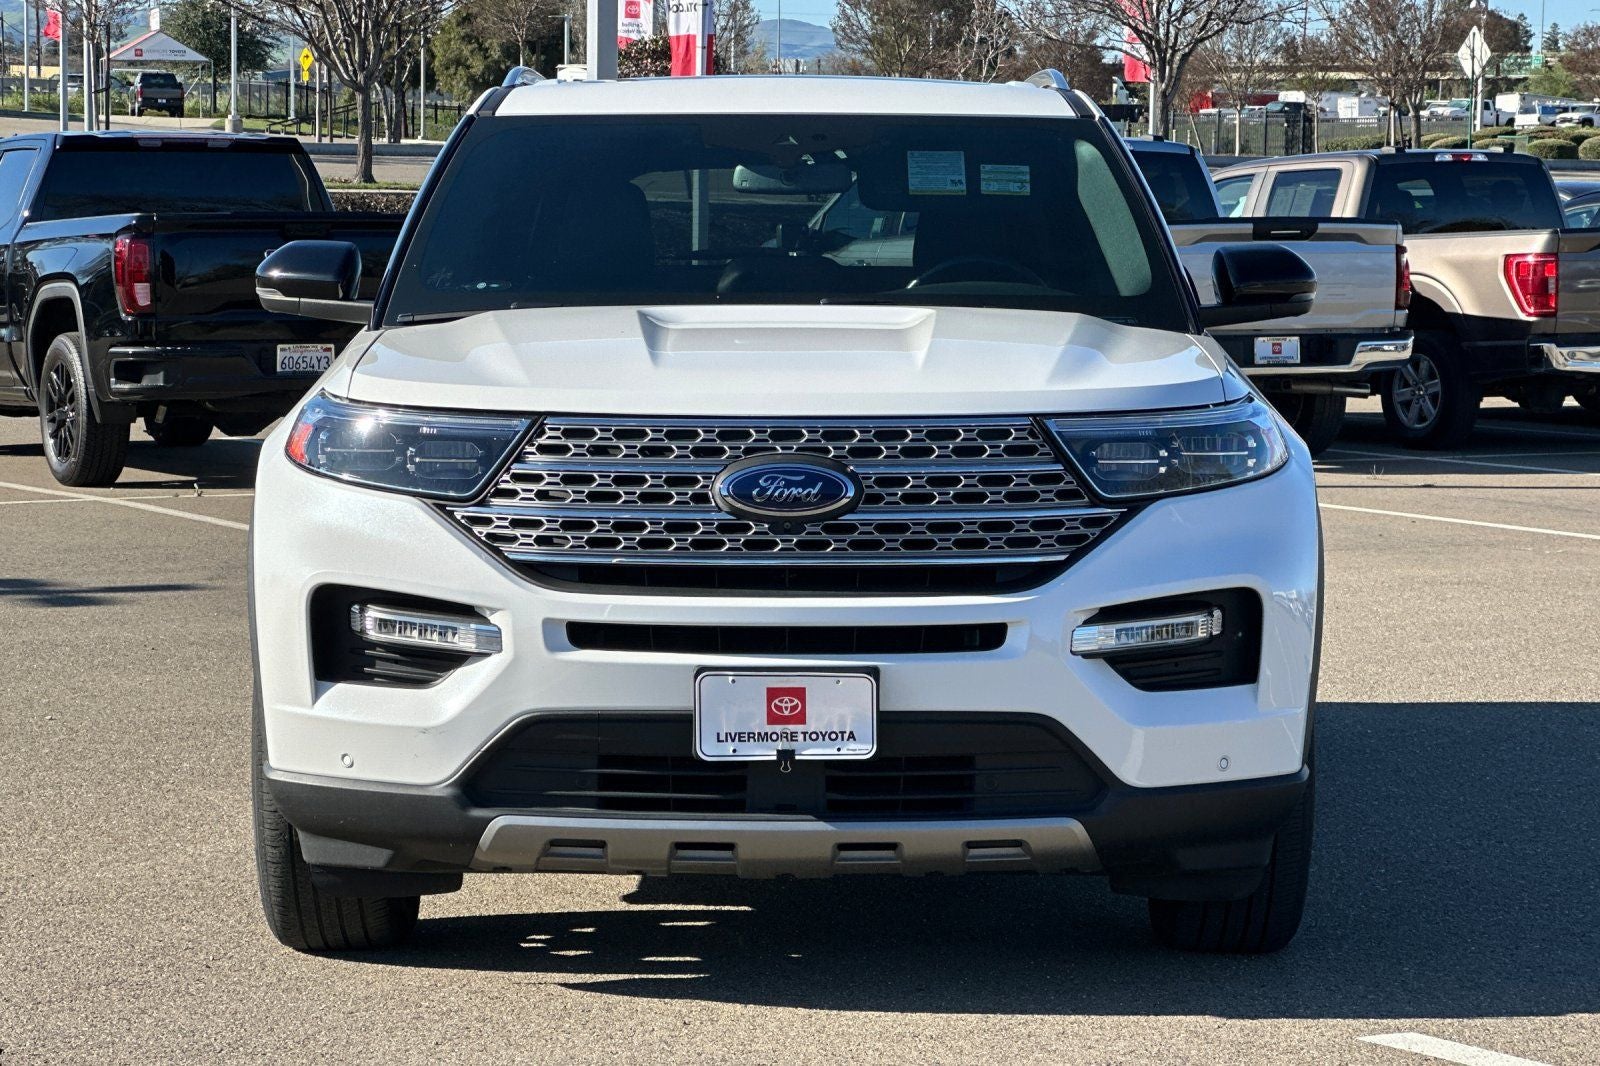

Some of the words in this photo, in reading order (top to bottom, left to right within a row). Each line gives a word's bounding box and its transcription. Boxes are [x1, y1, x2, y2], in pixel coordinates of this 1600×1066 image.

[280, 355, 331, 370] 60654Y3
[752, 473, 823, 502] Ford
[716, 731, 799, 743] LIVERMORE
[801, 730, 857, 742] TOYOTA
